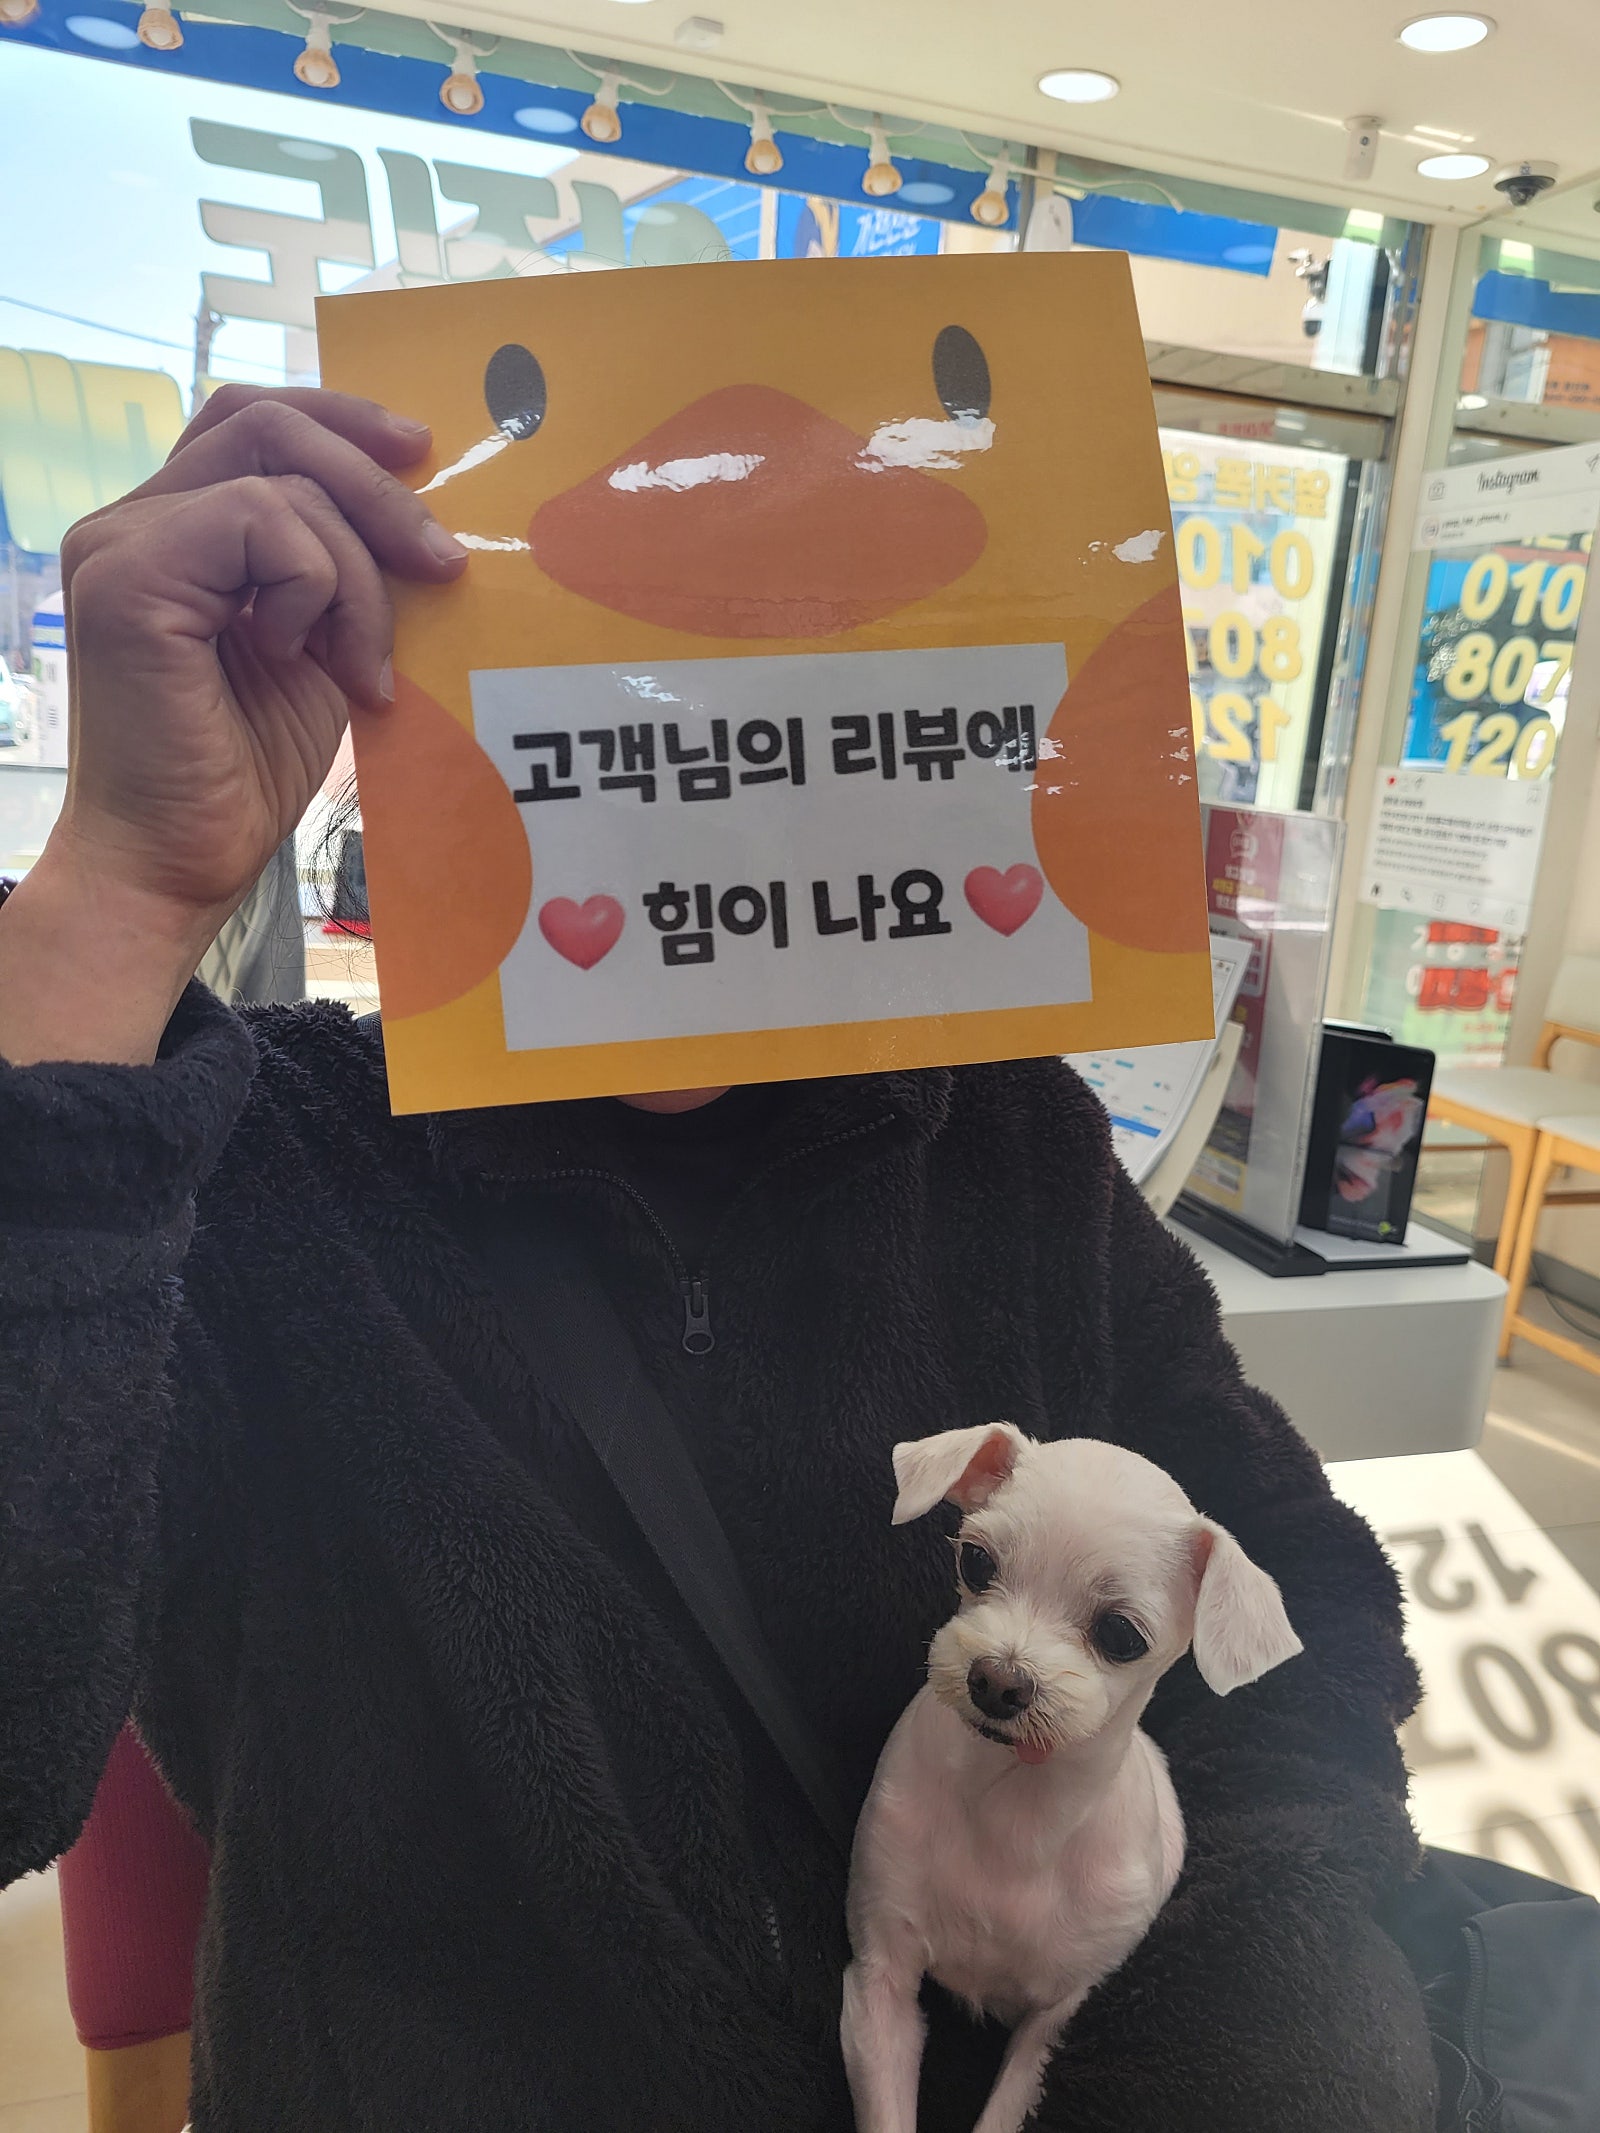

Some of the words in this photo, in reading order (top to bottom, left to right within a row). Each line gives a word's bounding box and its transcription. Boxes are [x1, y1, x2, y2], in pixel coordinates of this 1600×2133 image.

[1477, 468, 1541, 495] Instagram
[512, 717, 807, 804] 고객님의
[832, 703, 1039, 782] 리뷰에
[643, 879, 789, 966] 힘이
[813, 868, 952, 944] 나요
